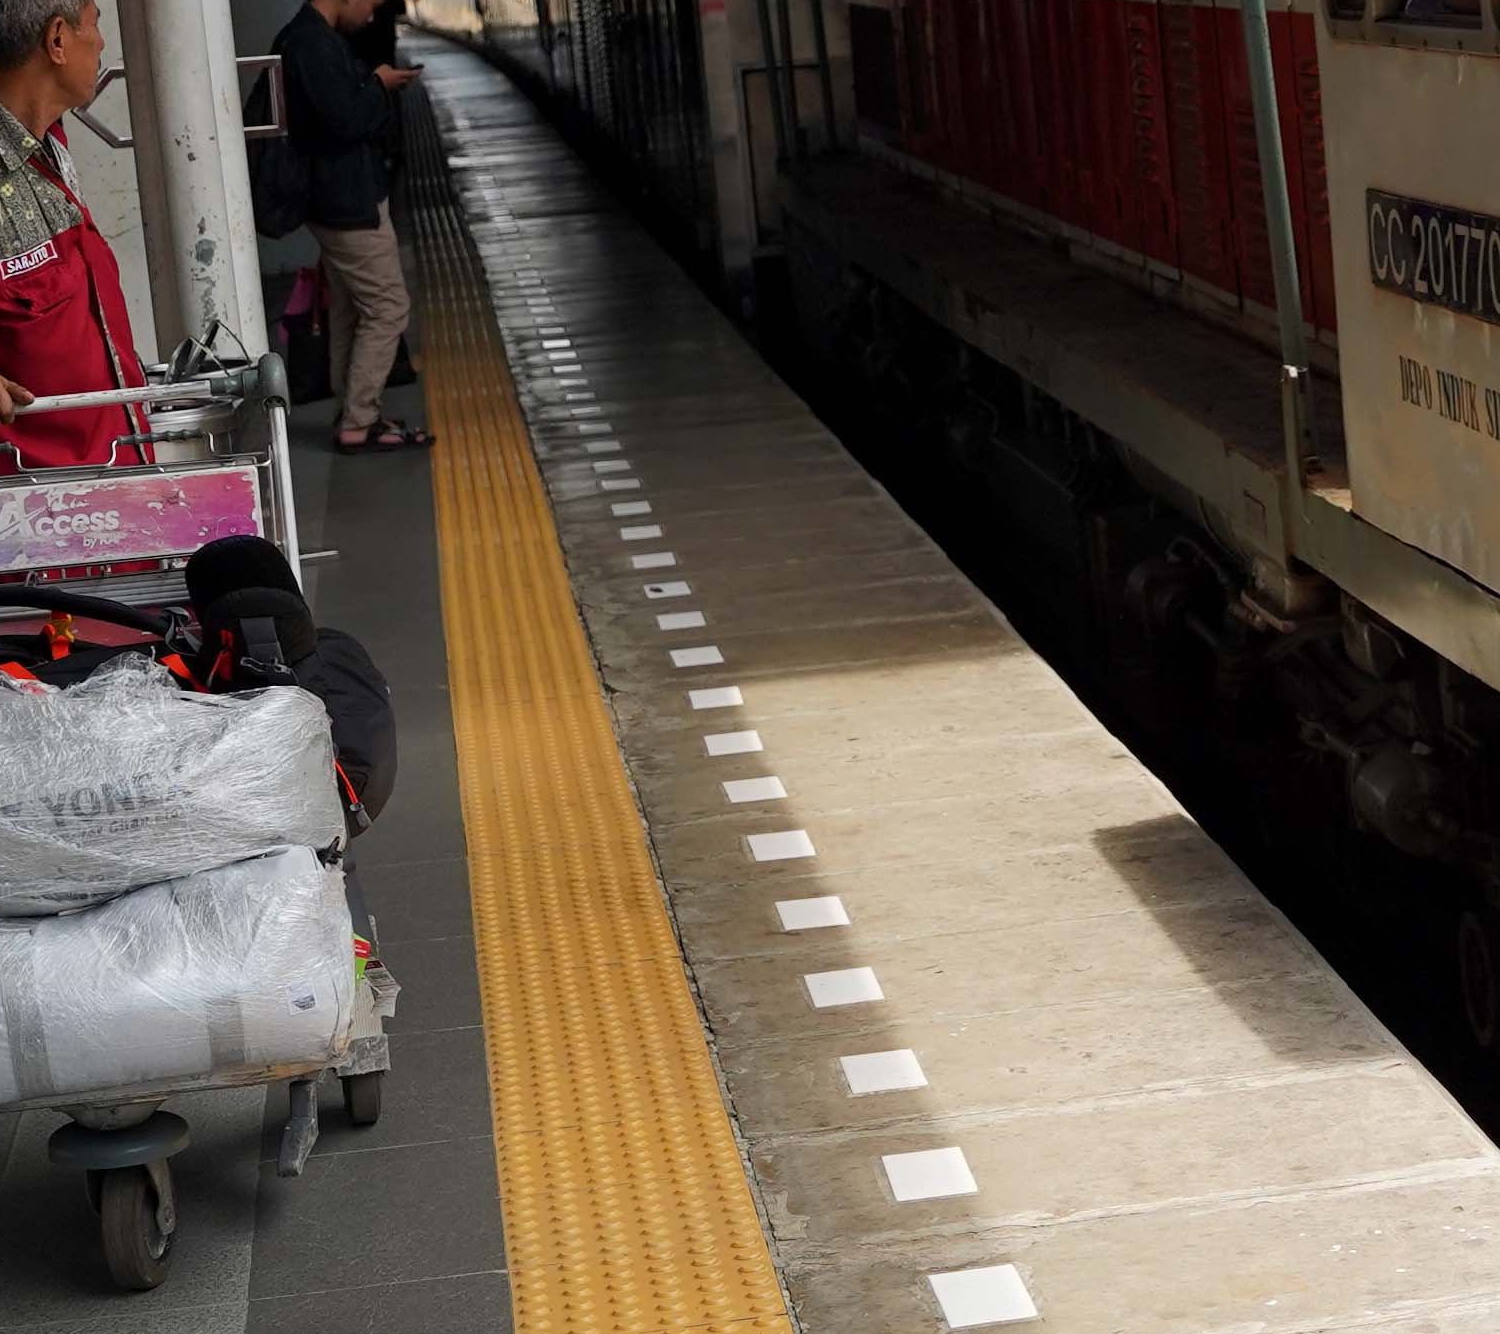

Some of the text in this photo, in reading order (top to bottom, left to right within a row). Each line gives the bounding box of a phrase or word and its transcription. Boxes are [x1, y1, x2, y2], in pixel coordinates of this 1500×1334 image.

[1369, 200, 1406, 286] CC
[1398, 354, 1434, 411] DEPO
[1437, 369, 1481, 432] INDUK
